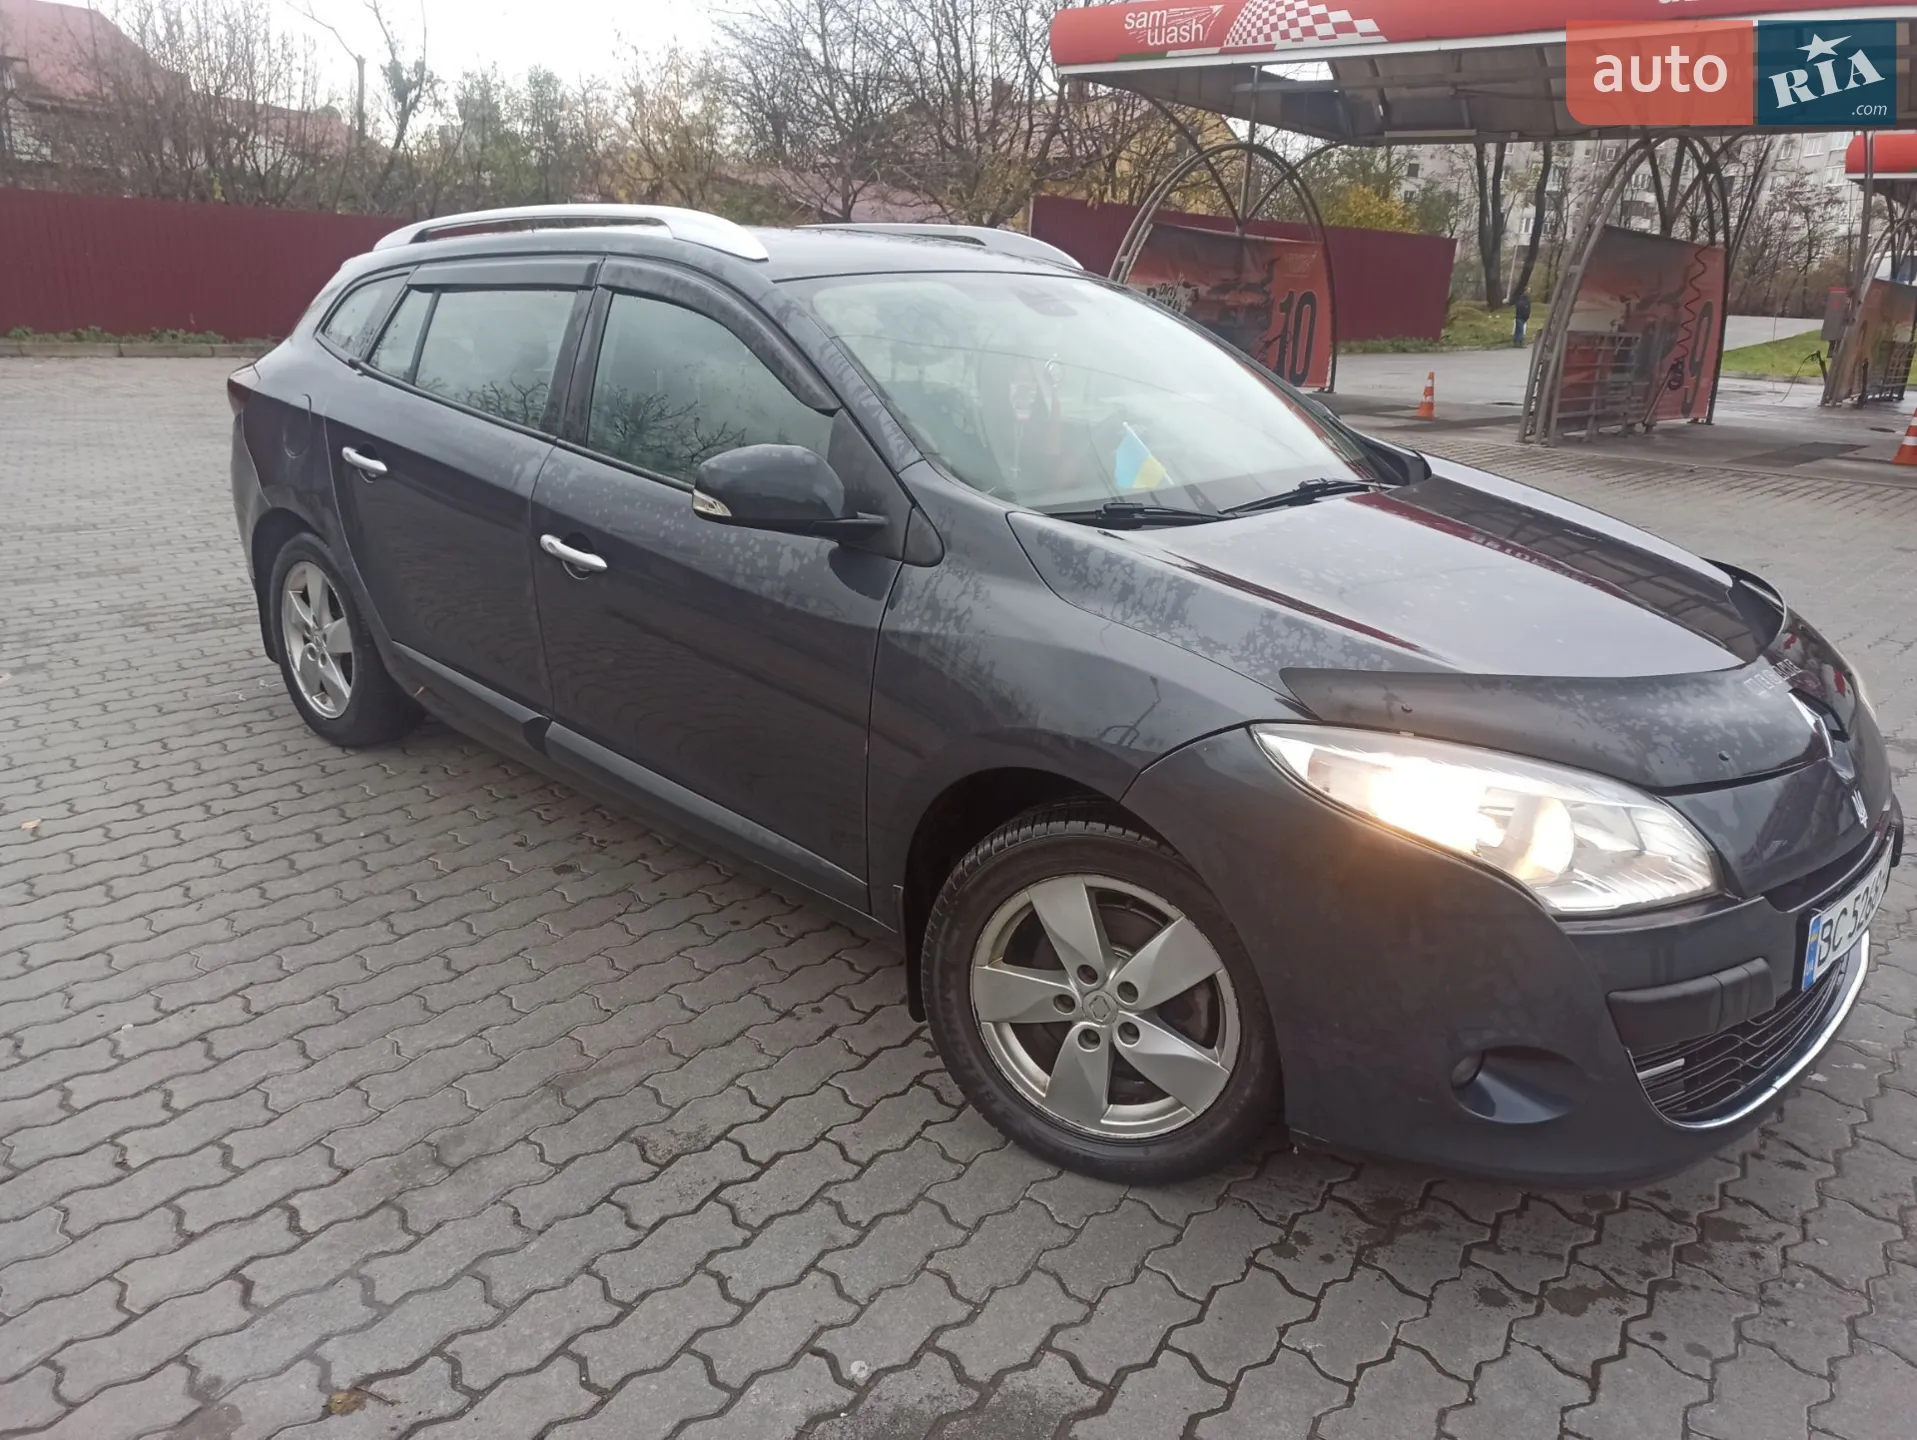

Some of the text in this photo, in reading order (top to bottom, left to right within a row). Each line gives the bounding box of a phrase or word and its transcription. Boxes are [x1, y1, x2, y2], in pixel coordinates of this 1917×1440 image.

[1124, 9, 1167, 30] sam
[1147, 22, 1204, 46] wash
[1275, 290, 1318, 387] 10
[1817, 907, 1848, 968] BC
